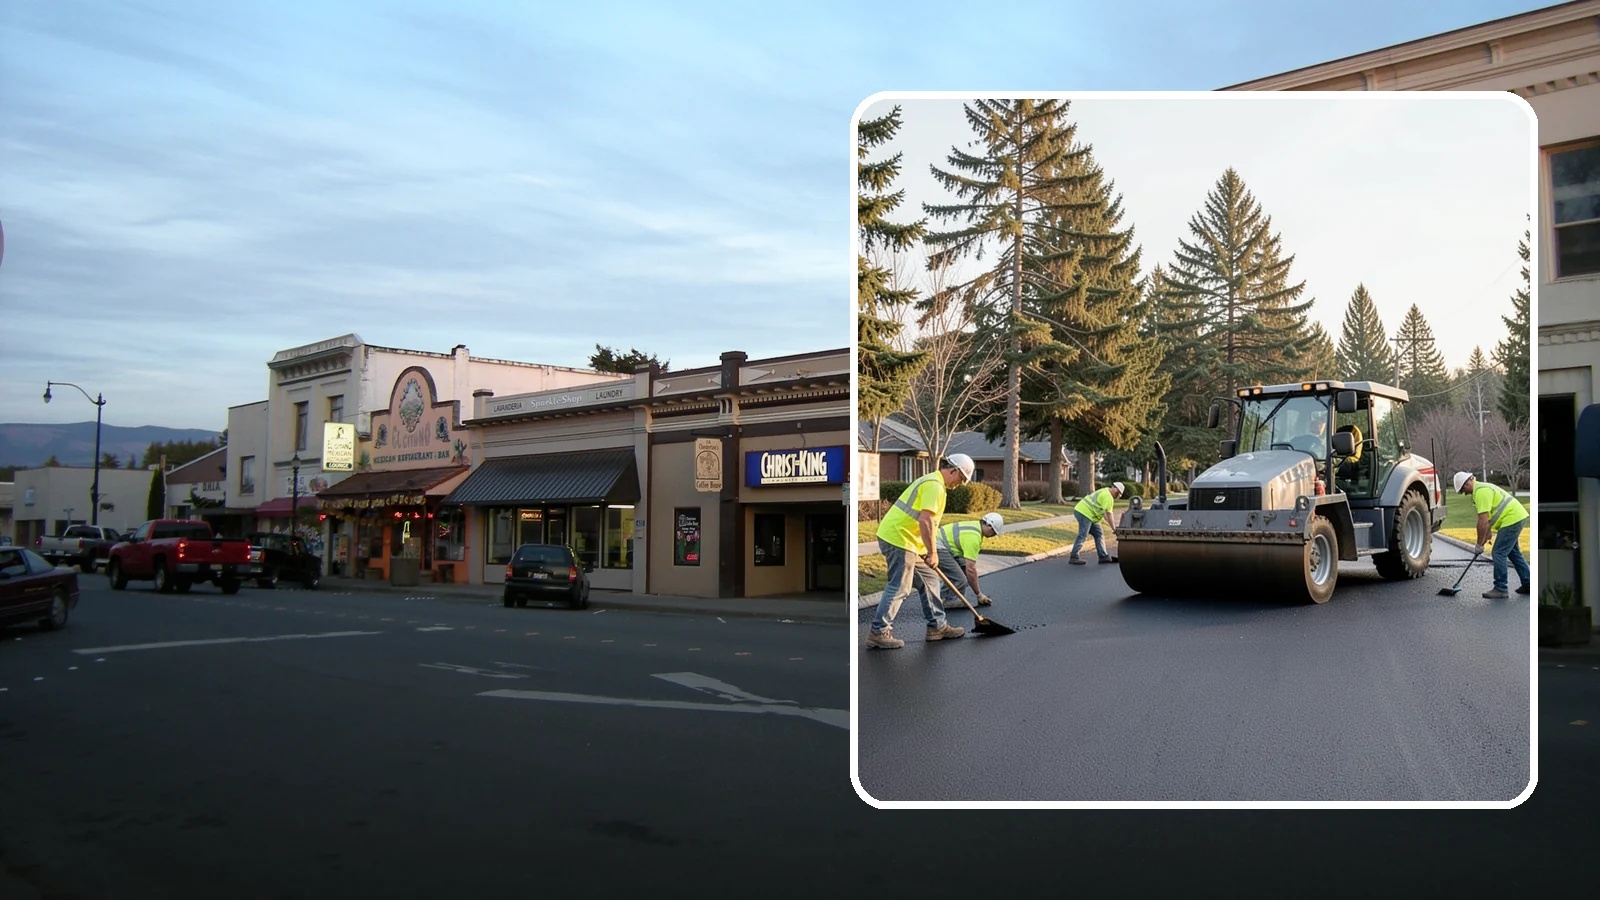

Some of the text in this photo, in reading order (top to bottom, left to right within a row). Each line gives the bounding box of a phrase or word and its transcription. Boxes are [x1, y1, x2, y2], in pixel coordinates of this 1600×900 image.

[493, 402, 522, 413] LAVANDERIA
[562, 394, 583, 405] Shop
[595, 389, 623, 400] LAUNDRY
[373, 455, 396, 464] MEXICAN
[397, 451, 434, 463] RESTAURANT
[437, 449, 450, 459] BAR
[798, 449, 828, 477] KING
